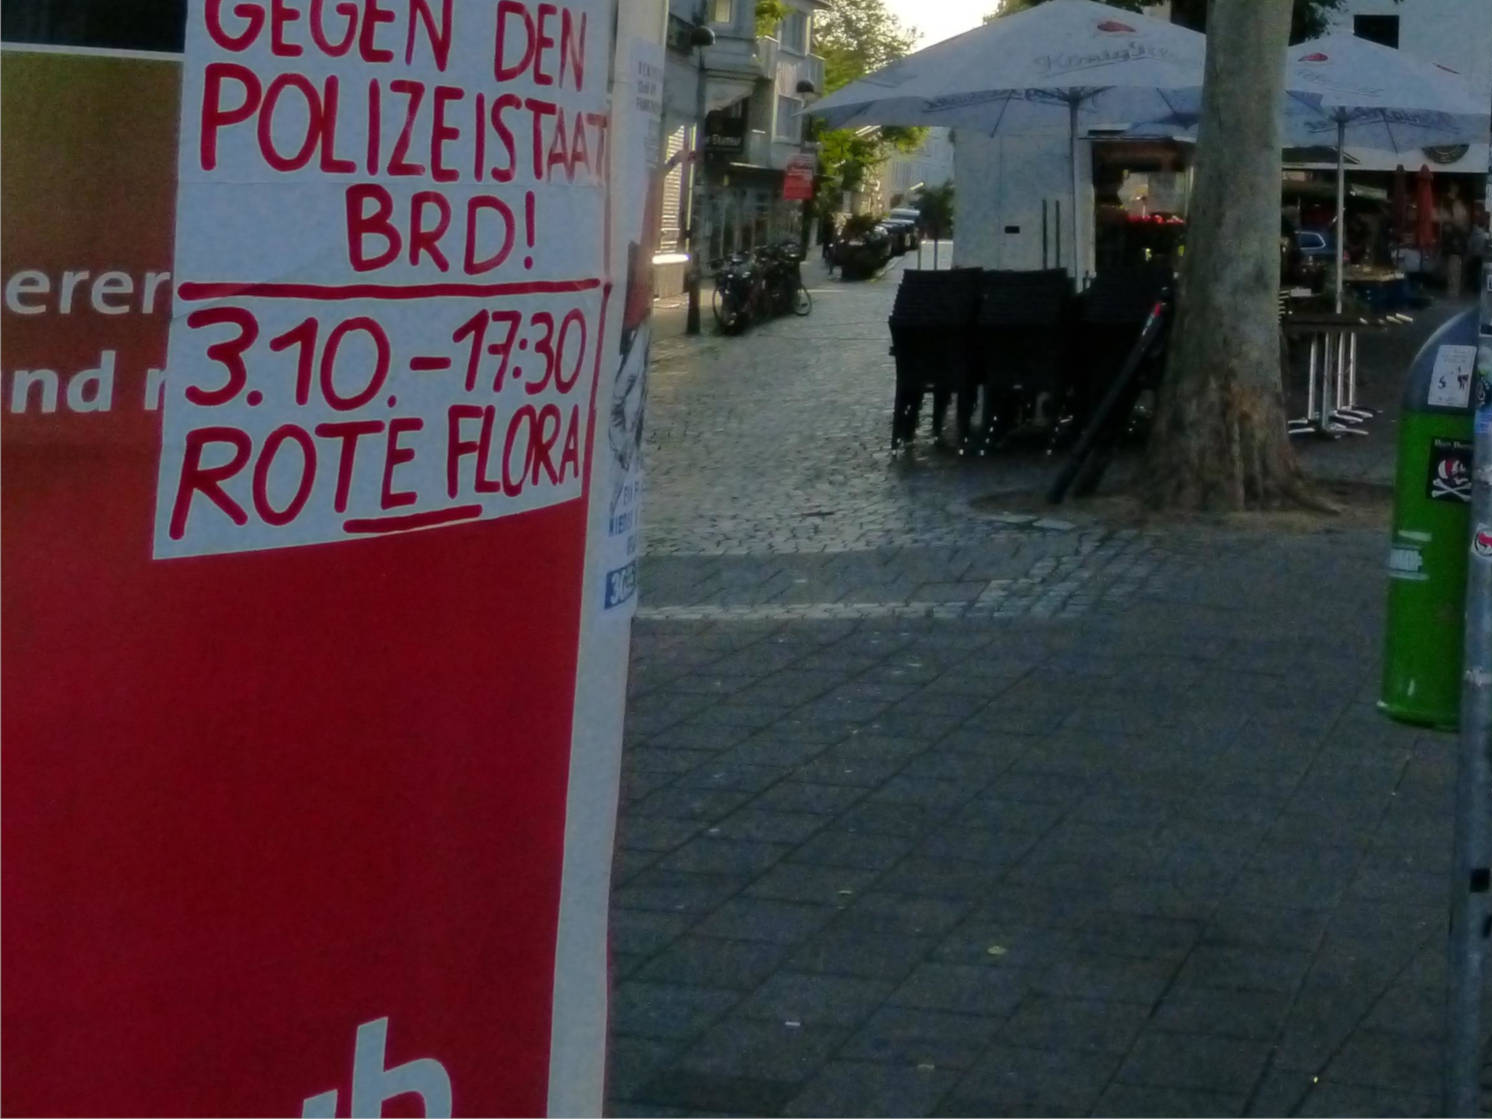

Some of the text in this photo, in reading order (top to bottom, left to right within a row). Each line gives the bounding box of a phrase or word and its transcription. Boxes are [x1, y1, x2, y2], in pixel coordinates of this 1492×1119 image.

[494, 0, 587, 92] DEN
[200, 62, 609, 184] POLIZEISTAAT
[346, 183, 535, 276] BRD!
[5, 269, 171, 315] erer
[10, 349, 117, 414] nd
[169, 404, 581, 541] ROTE FLORA
